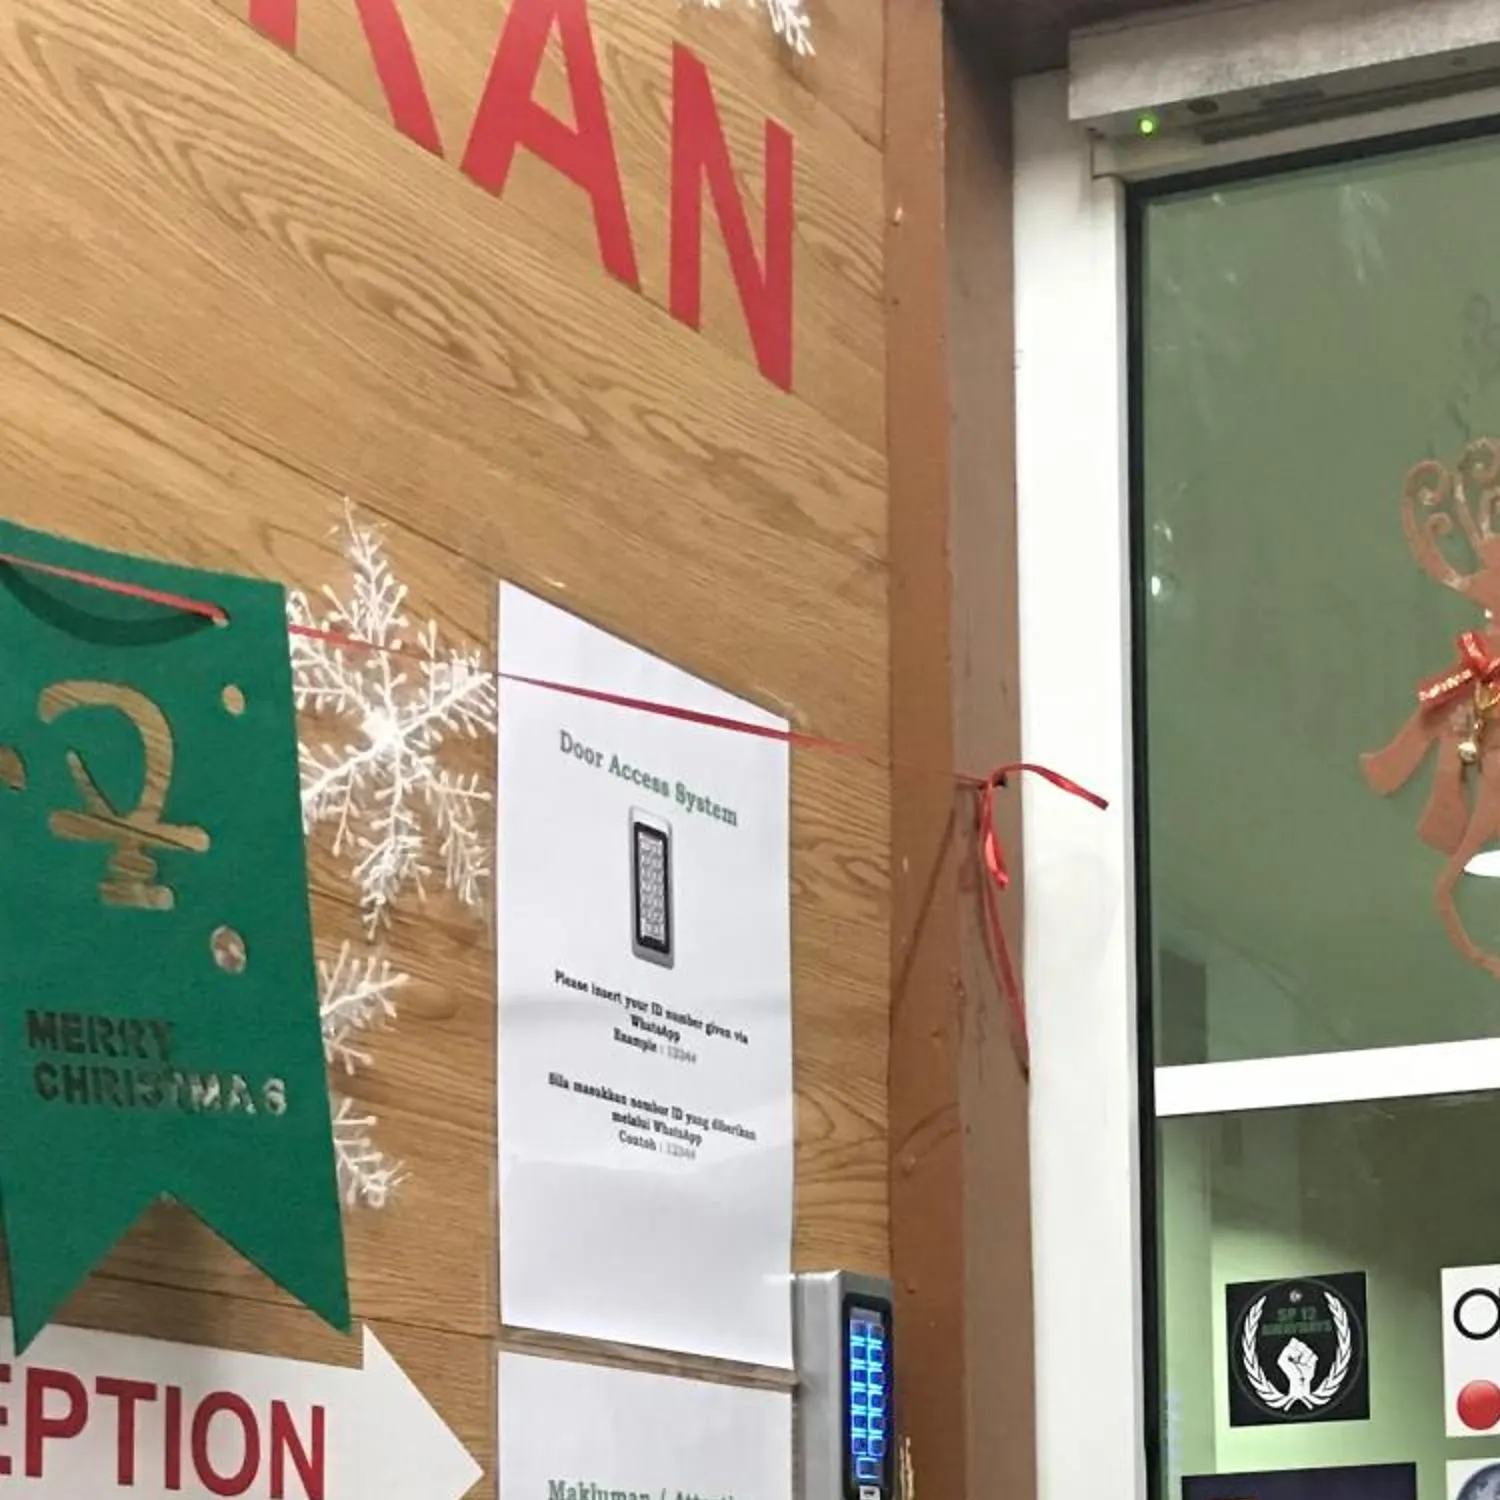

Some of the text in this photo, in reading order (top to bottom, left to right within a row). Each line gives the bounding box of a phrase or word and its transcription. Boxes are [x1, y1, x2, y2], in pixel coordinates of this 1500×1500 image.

[560, 729, 737, 826] Door Access System
[555, 969, 749, 1044] Please insert your ID number given via
[630, 1014, 681, 1043] WhatsApp
[26, 1009, 174, 1061] MERRY
[614, 1027, 657, 1053] Example
[33, 1061, 287, 1116] CHRISTMAS
[549, 1072, 569, 1089] Sila
[573, 1081, 627, 1105] masukkan
[672, 1106, 683, 1120] ID
[686, 1113, 709, 1131] yang
[712, 1118, 756, 1140] diberikan
[612, 1112, 702, 1146] melalui WhatsApp
[619, 1129, 657, 1151] Contoh
